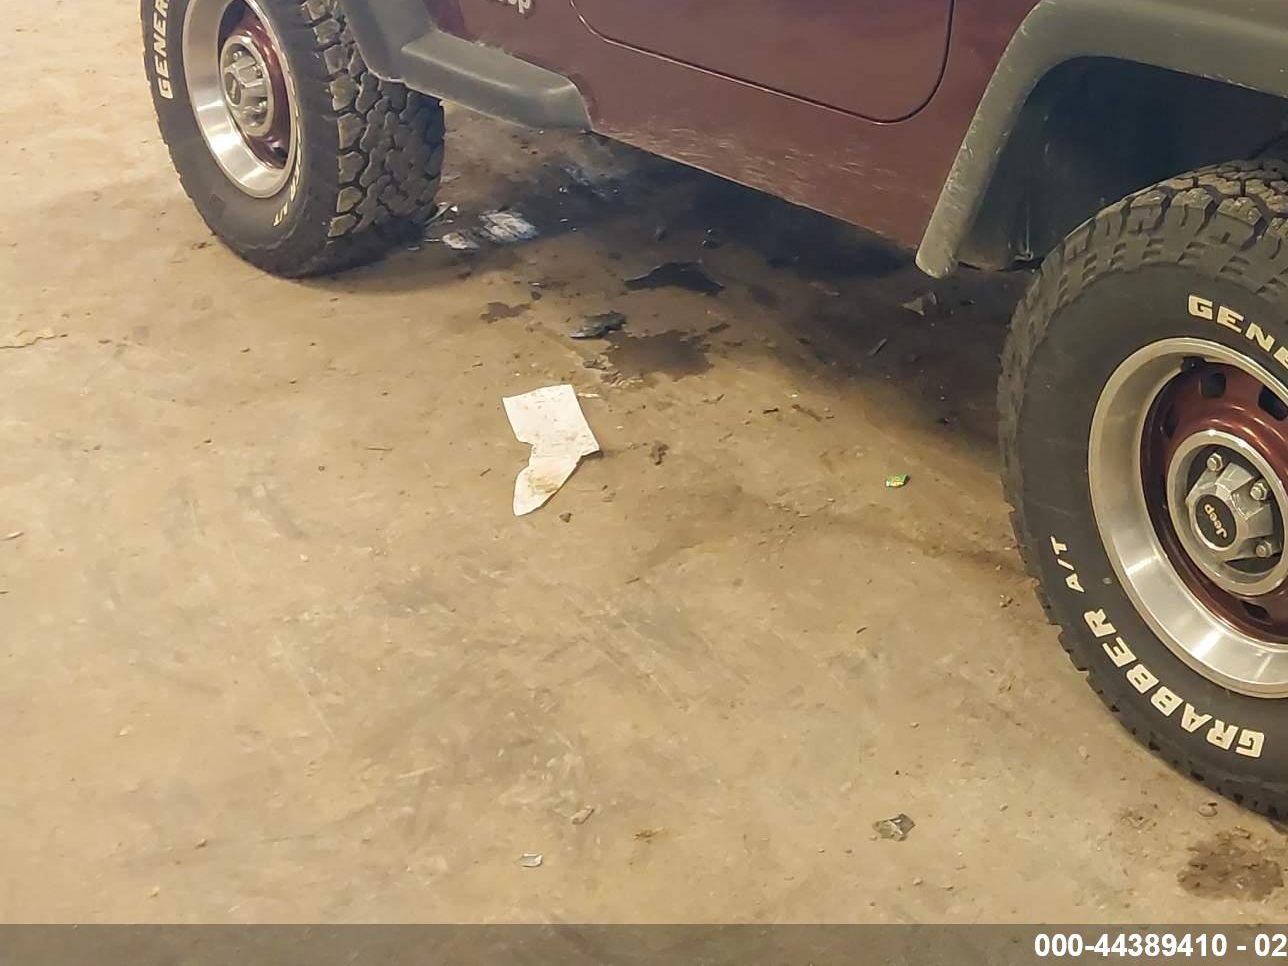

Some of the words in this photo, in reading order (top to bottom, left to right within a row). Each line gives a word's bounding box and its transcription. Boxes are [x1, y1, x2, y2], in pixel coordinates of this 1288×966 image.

[1203, 503, 1229, 539] Jeep
[1047, 535, 1087, 594] A/T
[1084, 607, 1266, 760] GRABBER
